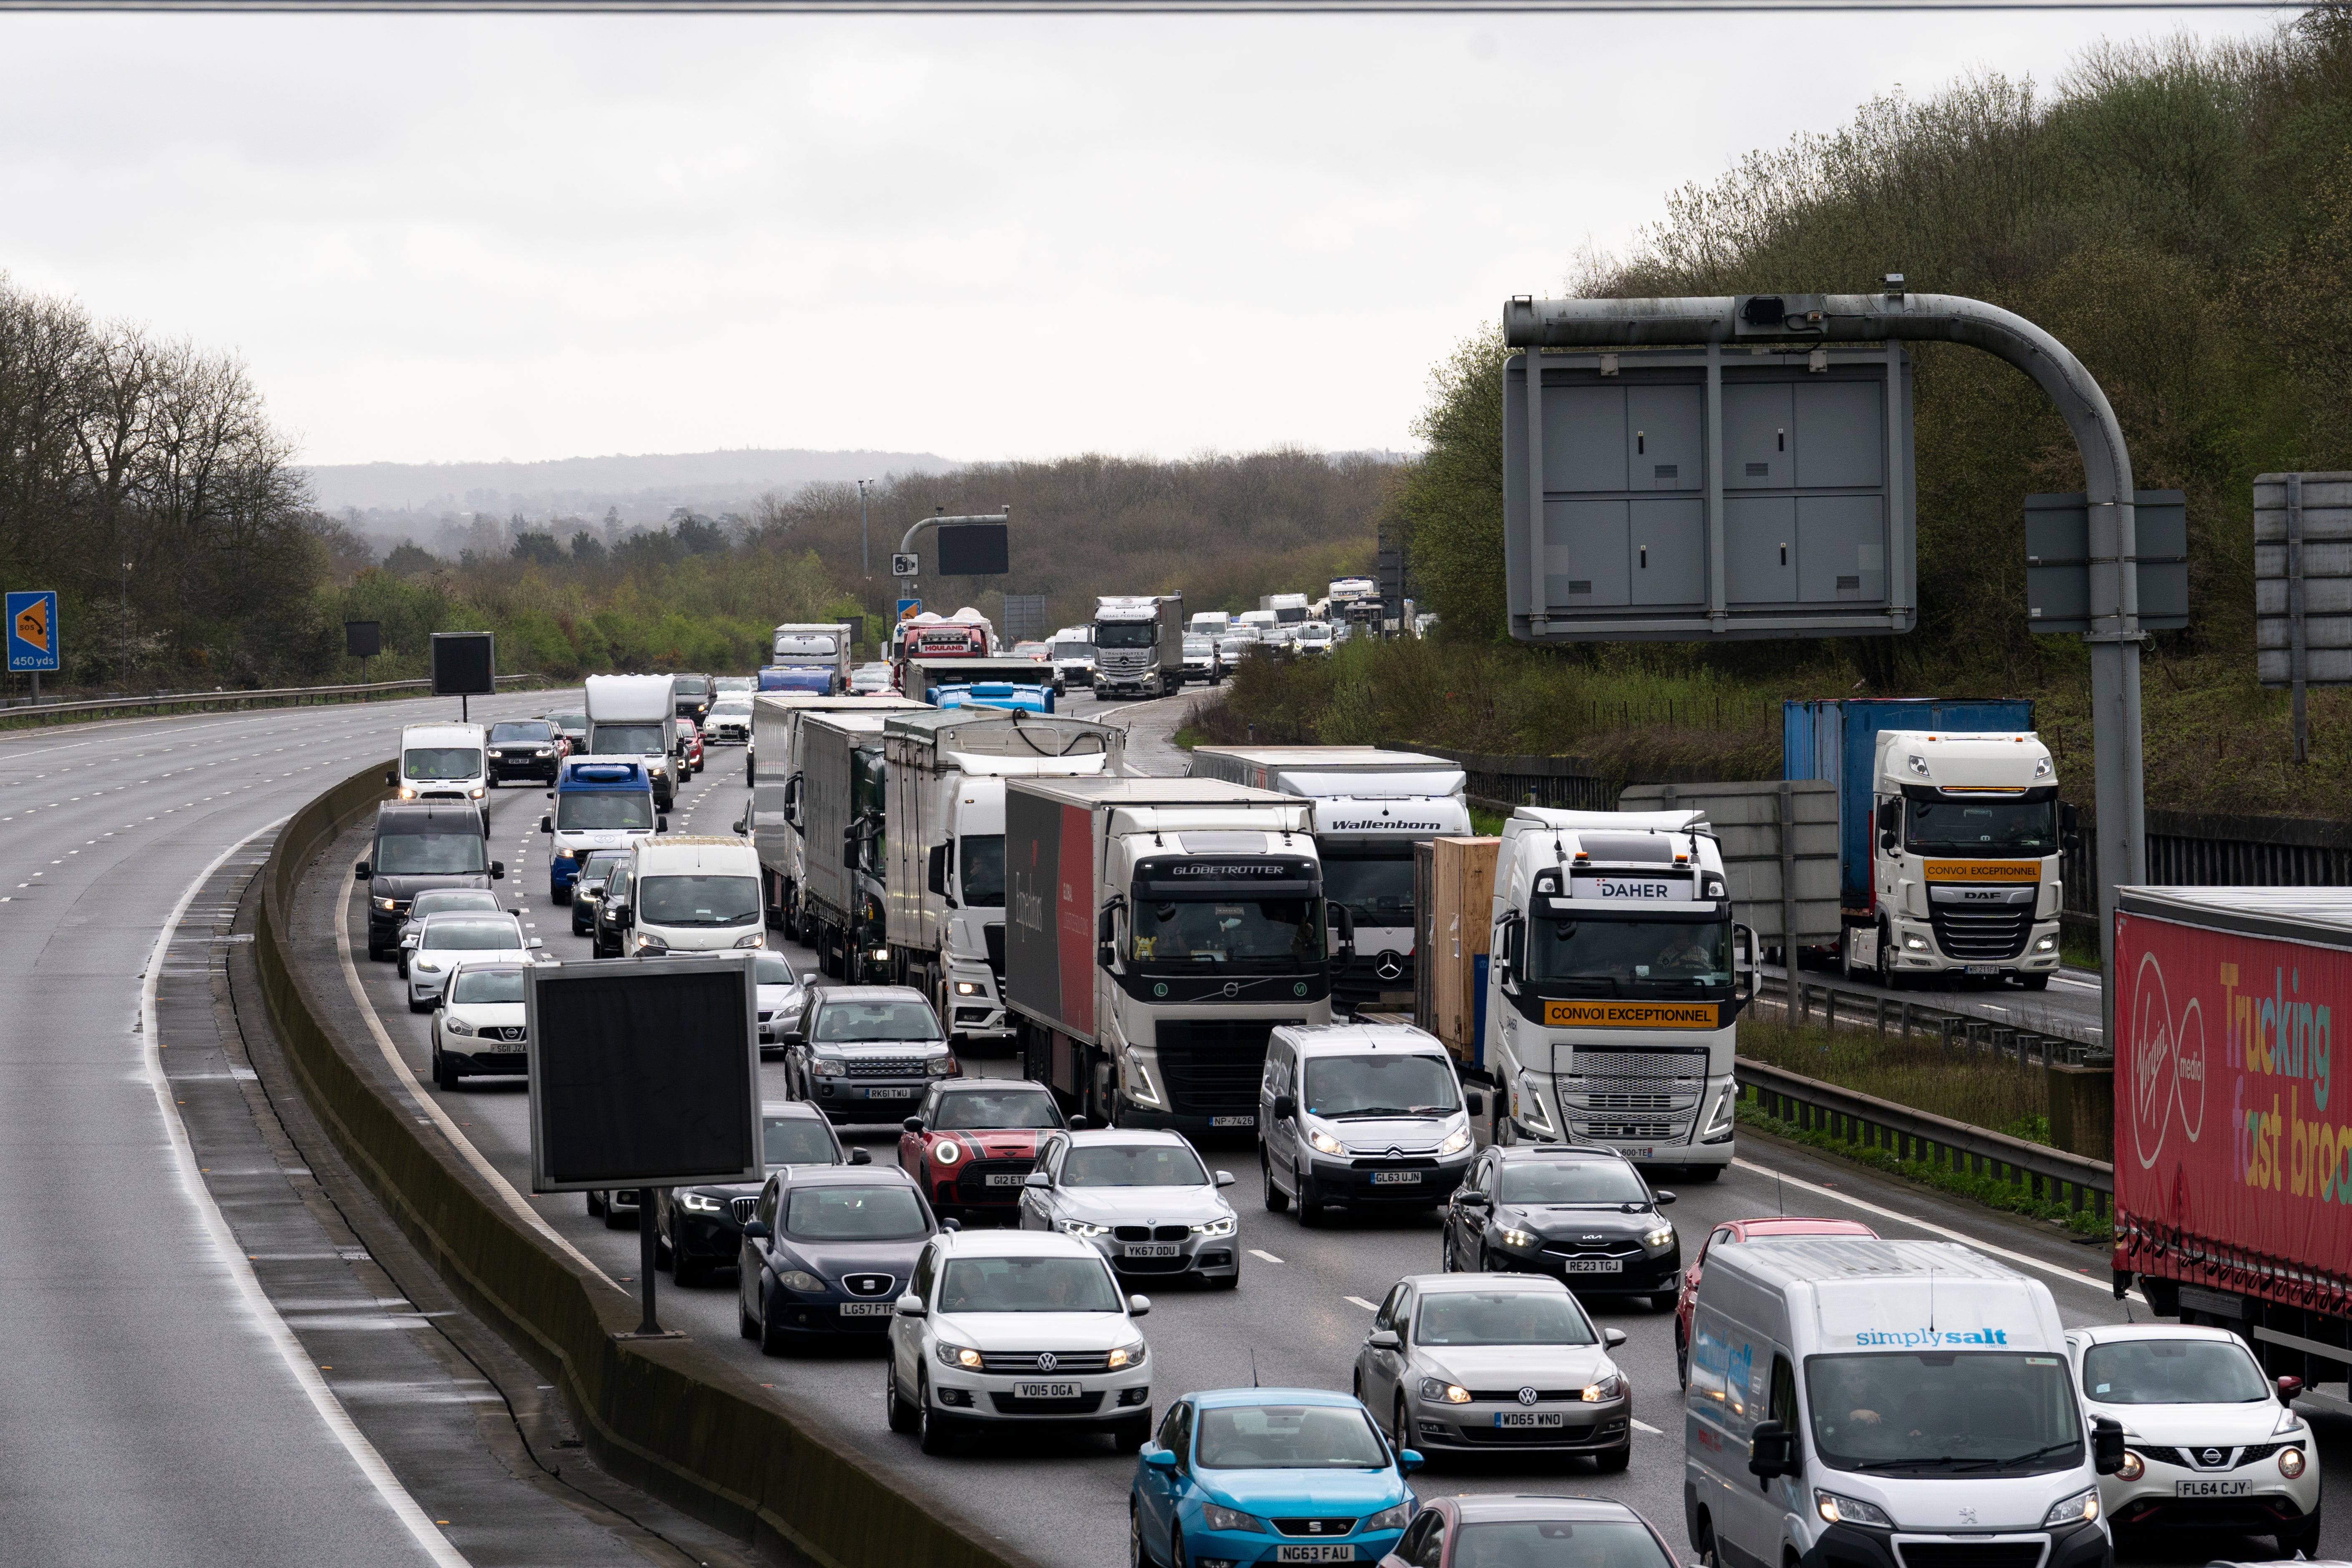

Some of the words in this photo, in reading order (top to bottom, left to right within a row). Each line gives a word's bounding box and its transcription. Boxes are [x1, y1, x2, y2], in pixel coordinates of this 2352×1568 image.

[13, 656, 34, 666] 450
[36, 656, 54, 667] yds
[1332, 820, 1441, 829] Wallenborn
[1173, 866, 1284, 875] GLOBETROTTER
[1971, 867, 2037, 875] EXCEPTIONNEL
[1602, 883, 1668, 898] DAHER
[1551, 1007, 1604, 1020] CONVOI
[1608, 1008, 1712, 1022] EXCEPTIONNEL
[2220, 961, 2330, 1112] Trucking
[2137, 991, 2167, 1129] Virgin
[2180, 1051, 2202, 1081] media
[2232, 1074, 2282, 1192] fast
[2290, 1085, 2352, 1206] broa
[994, 1176, 1008, 1184] G12
[1376, 1173, 1399, 1182] GL63
[1402, 1173, 1419, 1182] UJN
[1129, 1246, 1154, 1255] YK67
[1156, 1246, 1175, 1255] ODU
[1570, 1261, 1596, 1271] RE23
[1598, 1261, 1618, 1271] TGJ
[845, 1304, 872, 1314] LG57
[875, 1304, 895, 1314] FTF
[1022, 1384, 1048, 1396] VO15
[1051, 1384, 1074, 1396] OGA
[1503, 1414, 1534, 1425] WD65
[1538, 1414, 1560, 1425] WNO
[2183, 1482, 2218, 1495] FL64
[2221, 1482, 2246, 1495] CJY
[1283, 1547, 1318, 1560] NG63
[1322, 1547, 1349, 1559] FAU
